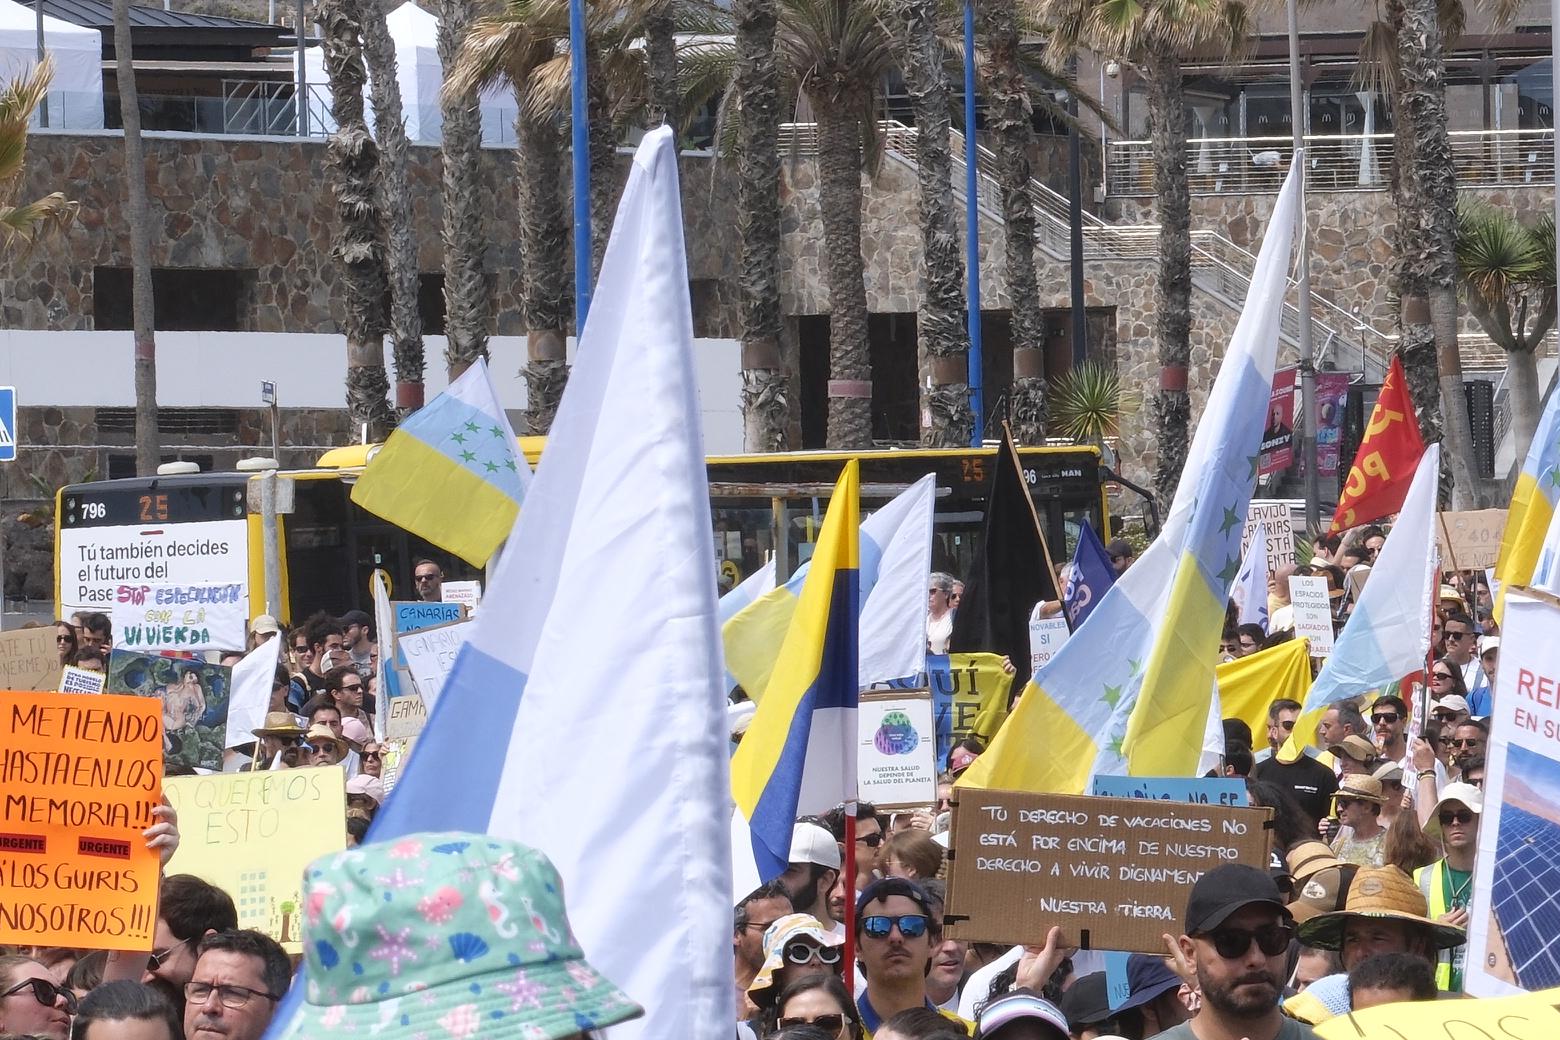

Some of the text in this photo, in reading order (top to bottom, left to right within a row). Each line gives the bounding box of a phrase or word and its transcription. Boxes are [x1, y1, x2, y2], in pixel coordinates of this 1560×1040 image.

[1023, 469, 1037, 484] 96
[81, 503, 107, 519] 796
[139, 495, 169, 521] 25
[1247, 504, 1287, 522] LAVIJO
[78, 539, 229, 562] Tú también decides
[1266, 533, 1291, 552] STÁ
[78, 561, 168, 581] el futuro del
[116, 585, 151, 606] STOP
[1295, 590, 1324, 598] ESPACIOS
[1031, 621, 1066, 631] NOVABLES
[1032, 653, 1050, 663] ERO
[12, 704, 158, 743] METIENDO
[1514, 707, 1538, 732] EN
[72, 757, 111, 787] EN
[114, 759, 159, 791] LOS
[195, 773, 321, 809] QUEREMOS
[206, 807, 280, 844] ESTO
[981, 806, 1247, 835] TU DERECHO DE VACACIONES NO
[79, 841, 129, 856] URGENTE
[979, 830, 1238, 860] ESTÁ POR ENCIMA DE NUESTRO
[10, 860, 49, 889] LOS
[54, 863, 139, 893] GUIRIS
[976, 857, 1203, 885] DERECHO A VIVIR DIGNAMEN
[1040, 897, 1106, 915] NUESTRA
